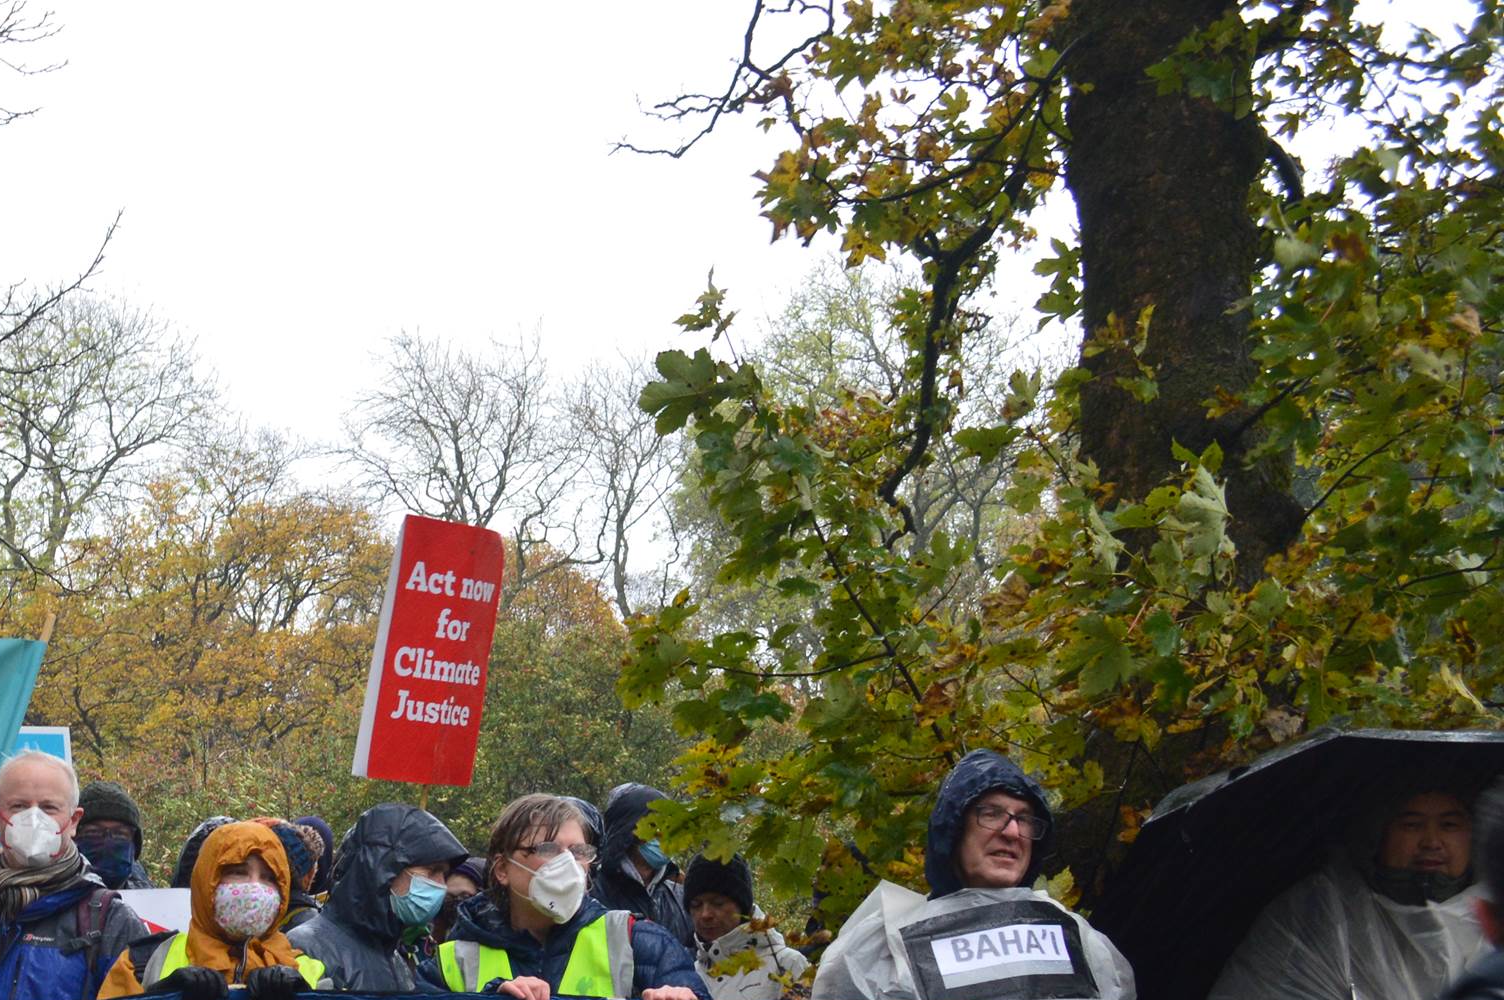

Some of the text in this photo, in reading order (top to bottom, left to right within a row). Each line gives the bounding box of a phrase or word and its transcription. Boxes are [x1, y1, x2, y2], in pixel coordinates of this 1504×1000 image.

[405, 561, 495, 604] Act now
[435, 608, 471, 642] for
[394, 646, 481, 686] Climate
[390, 690, 470, 727] Justice
[950, 927, 1061, 963] BAHA'I
